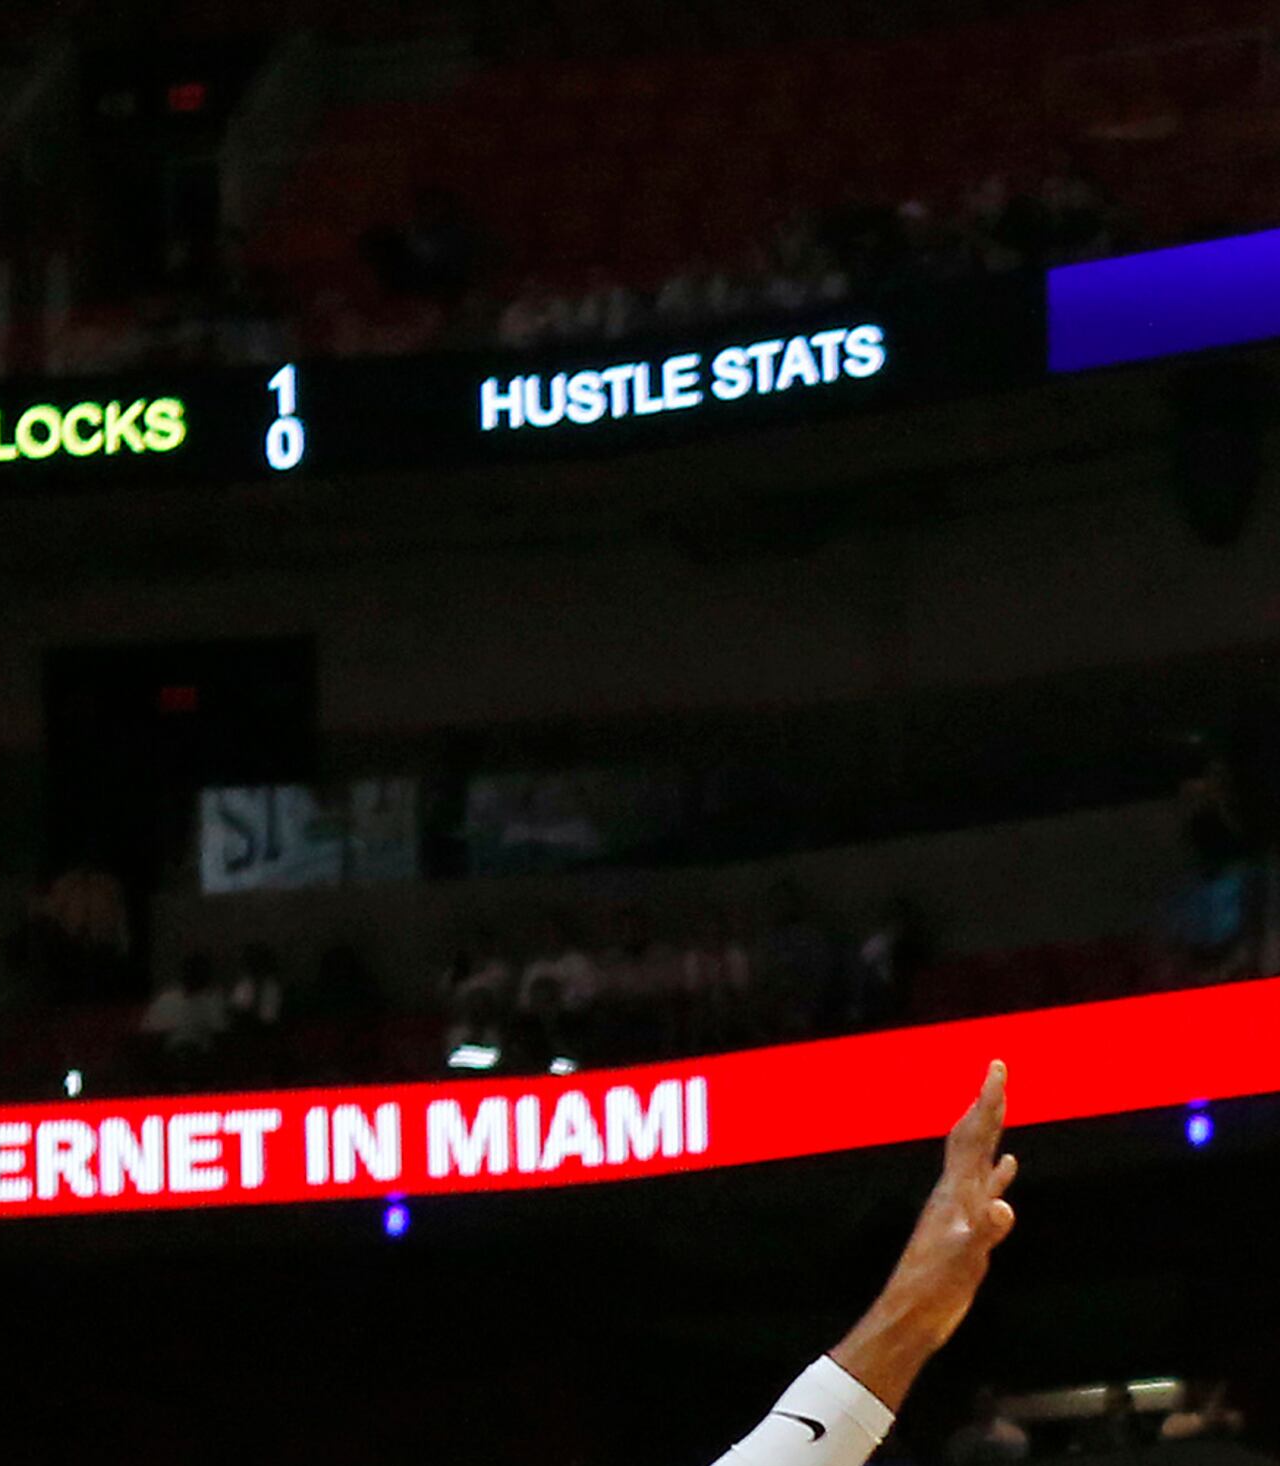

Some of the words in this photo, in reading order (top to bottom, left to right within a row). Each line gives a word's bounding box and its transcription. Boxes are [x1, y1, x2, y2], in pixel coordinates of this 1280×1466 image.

[267, 364, 296, 416] 1
[481, 353, 704, 430] HUSTLE
[711, 325, 885, 400] STATS
[265, 416, 305, 470] 0
[305, 1102, 402, 1185] IN
[426, 1077, 708, 1178] MIAMI
